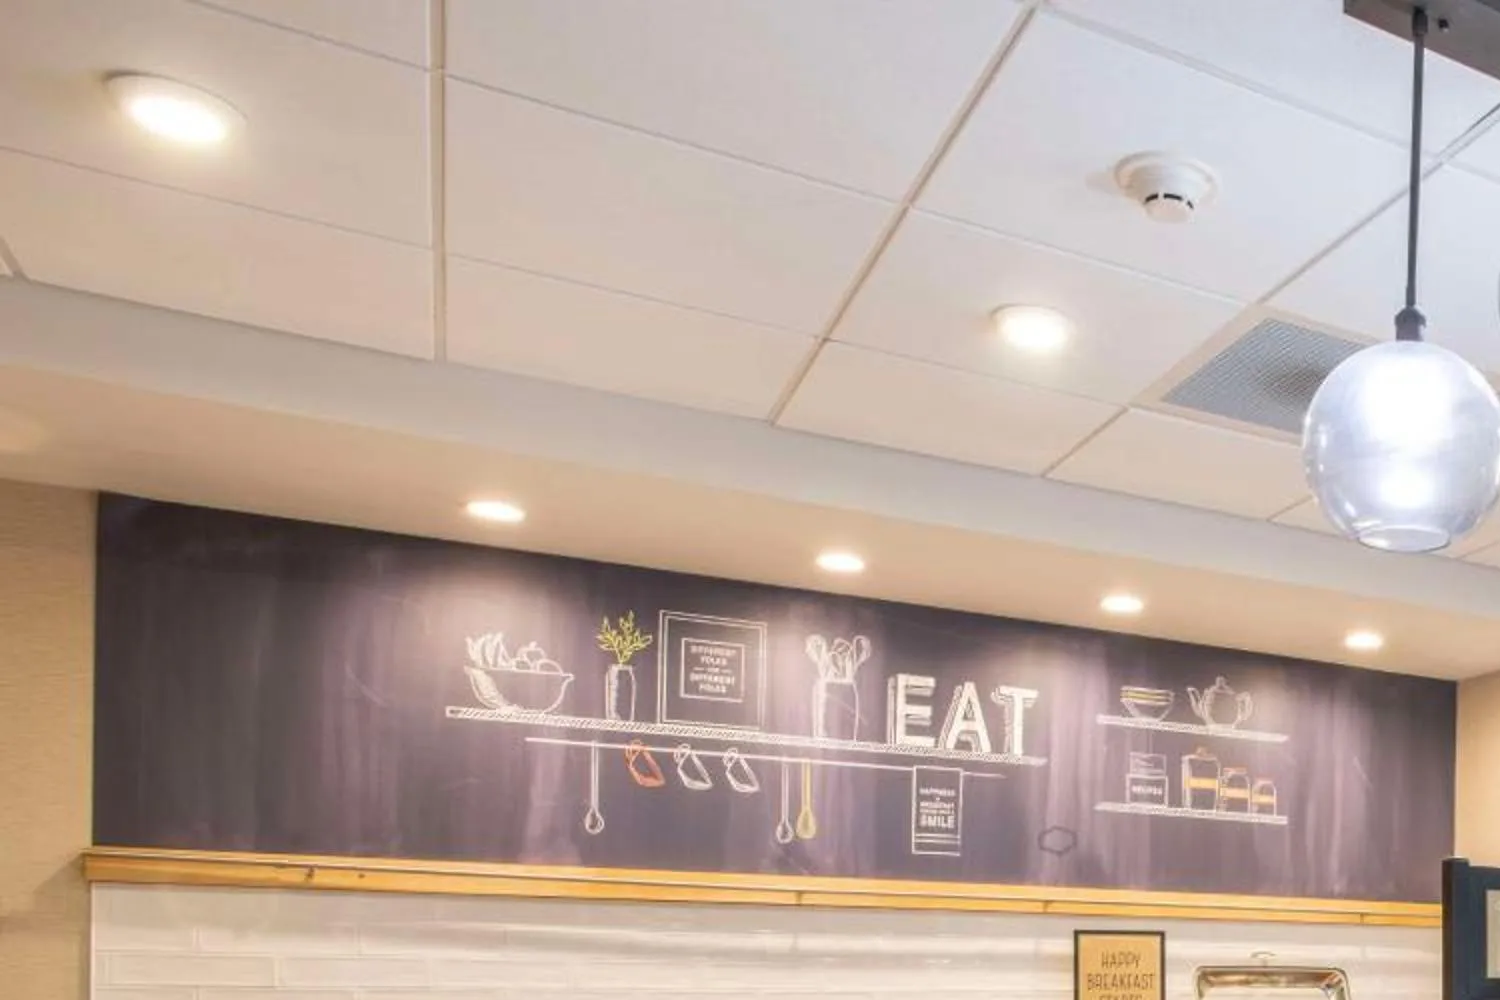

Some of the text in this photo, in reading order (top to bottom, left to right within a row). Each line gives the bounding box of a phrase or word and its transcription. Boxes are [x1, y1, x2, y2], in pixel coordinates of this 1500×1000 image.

[887, 673, 1040, 756] EAT
[1101, 951, 1141, 969] HAPPY
[1086, 973, 1156, 992] BREAKFAST
